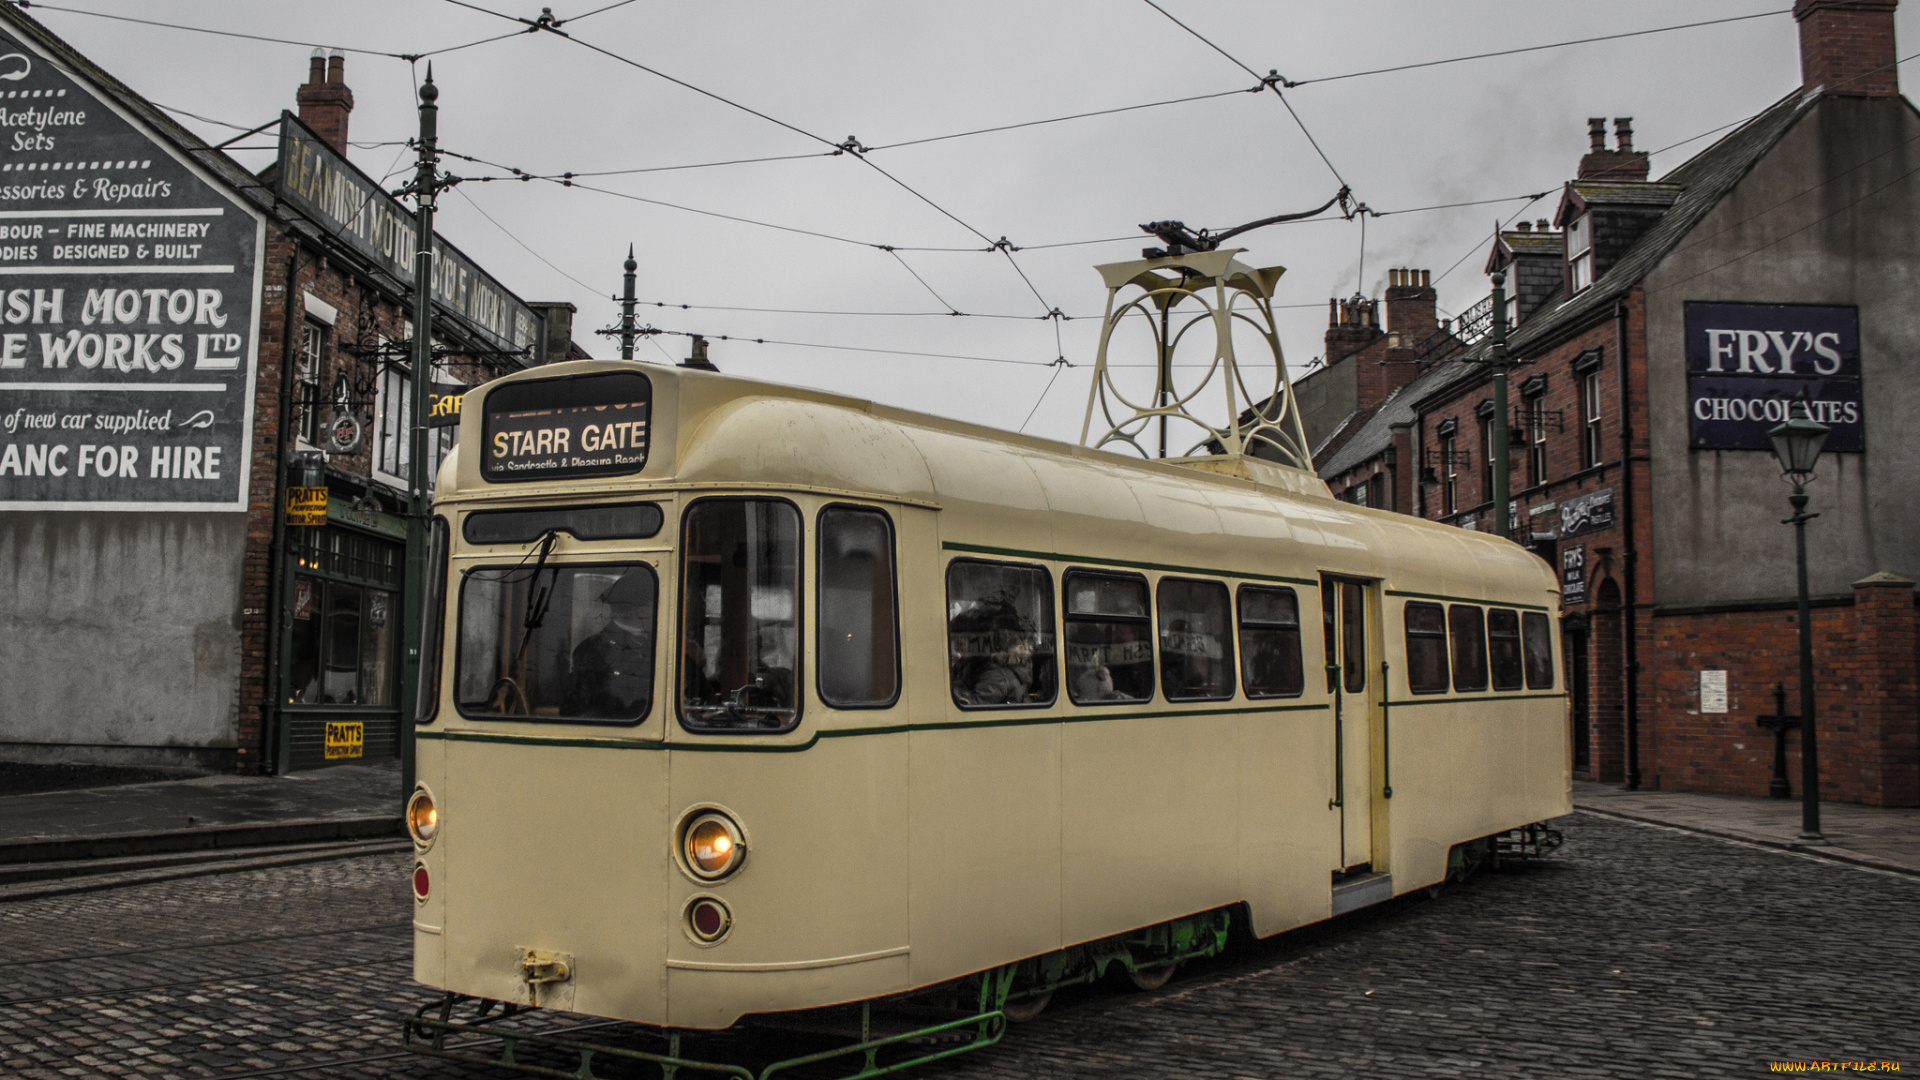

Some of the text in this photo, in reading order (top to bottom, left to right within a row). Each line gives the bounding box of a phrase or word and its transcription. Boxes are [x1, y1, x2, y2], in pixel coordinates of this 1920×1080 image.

[0, 106, 86, 131] Acetylene
[11, 131, 55, 151] Sets
[0, 177, 172, 203] ssories & Repairs
[287, 134, 366, 239] BEAMISH
[67, 223, 105, 238] FINE
[110, 222, 211, 238] MACHINERY
[0, 244, 202, 260] DIES DESIGNED & BUILT
[81, 288, 228, 328] MOTOR
[0, 333, 28, 368] E
[39, 329, 185, 373] WORKS
[1705, 328, 1841, 375] FRY'S
[4, 408, 171, 434] of new car supplied
[493, 421, 646, 458] STARR GATE
[0, 444, 221, 479] ANC FOR HIRE
